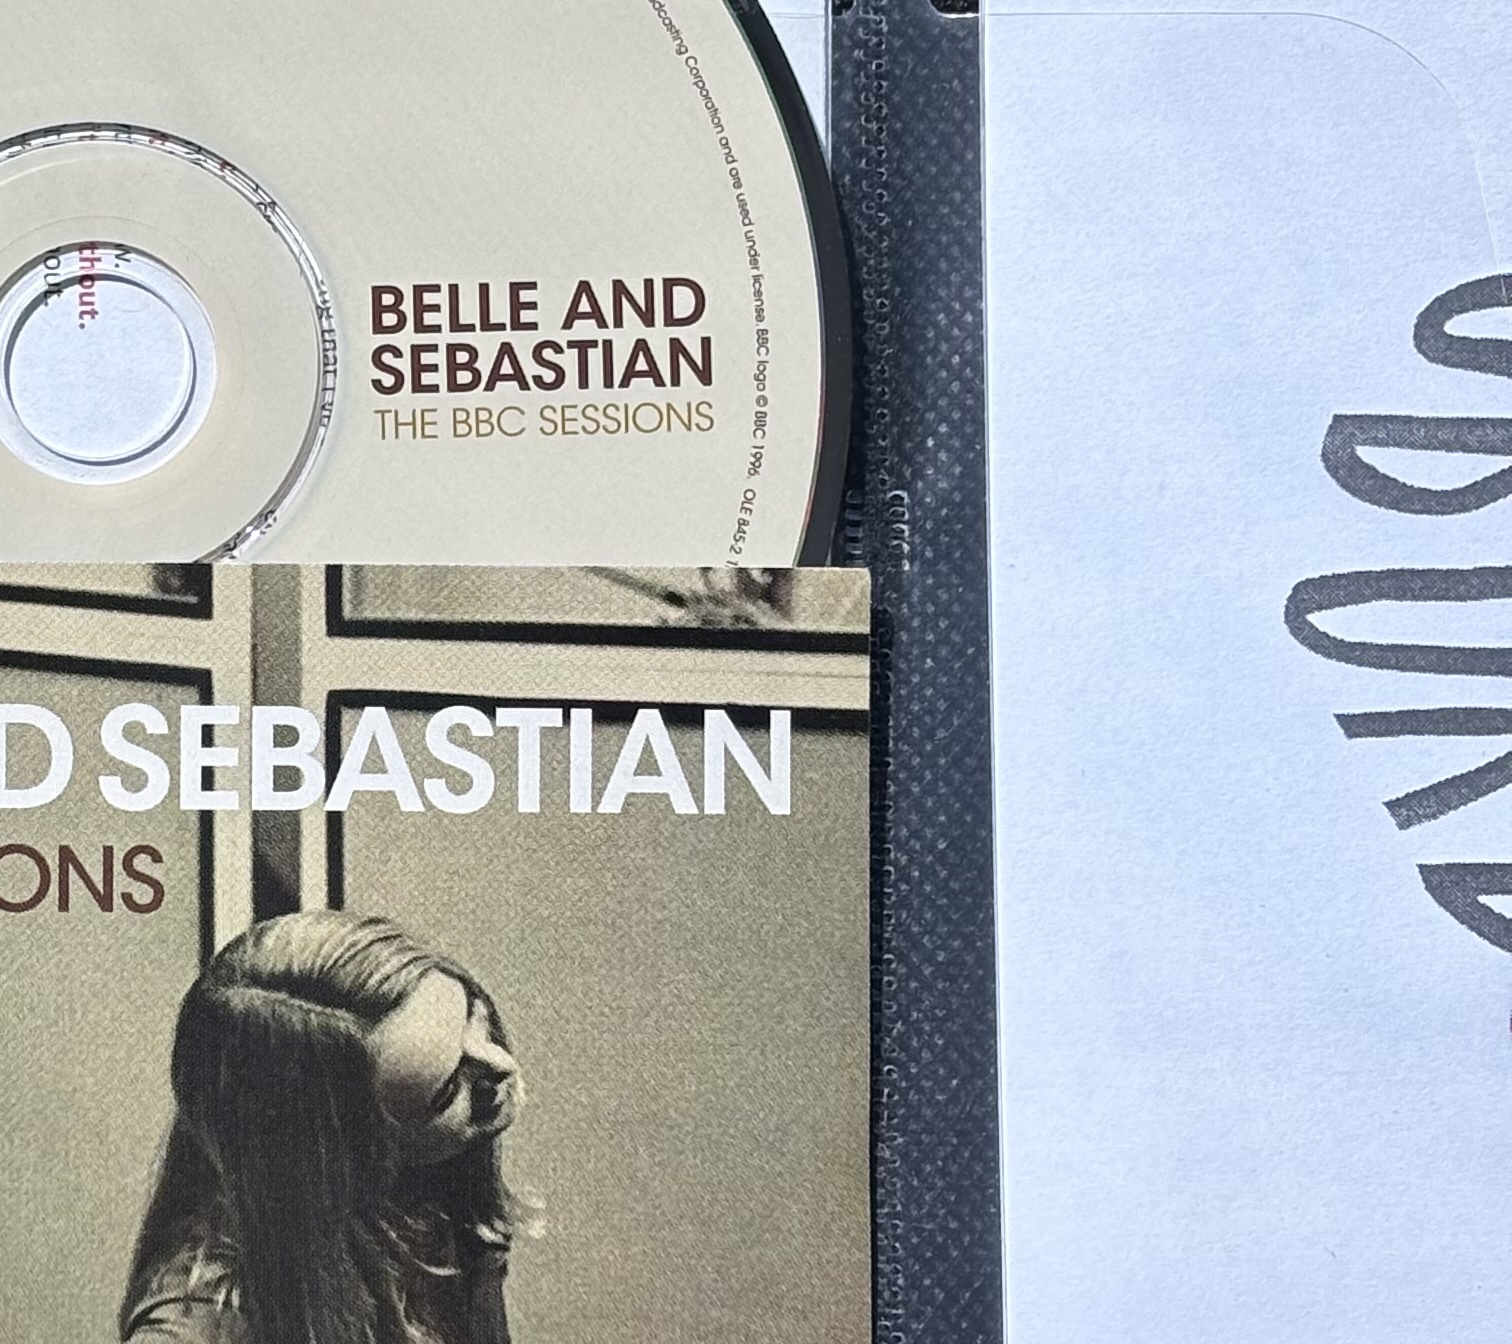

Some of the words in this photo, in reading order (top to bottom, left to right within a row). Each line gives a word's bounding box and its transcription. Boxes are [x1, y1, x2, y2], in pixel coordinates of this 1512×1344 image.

[684, 55, 725, 136] Corporation
[718, 135, 739, 166] and
[728, 166, 744, 191] are
[735, 192, 756, 228] used
[743, 229, 761, 272] under
[370, 280, 539, 336] BELLE
[560, 276, 707, 331] AND
[755, 328, 770, 358] BBC
[370, 335, 713, 396] SEBASTIAN
[752, 359, 770, 393] logo
[373, 407, 439, 441] THE
[451, 405, 527, 439] BBC
[538, 400, 715, 437] SESSIONS
[752, 410, 769, 441] BBC
[739, 488, 757, 517] OLE
[97, 701, 792, 816] SEBASTIAN
